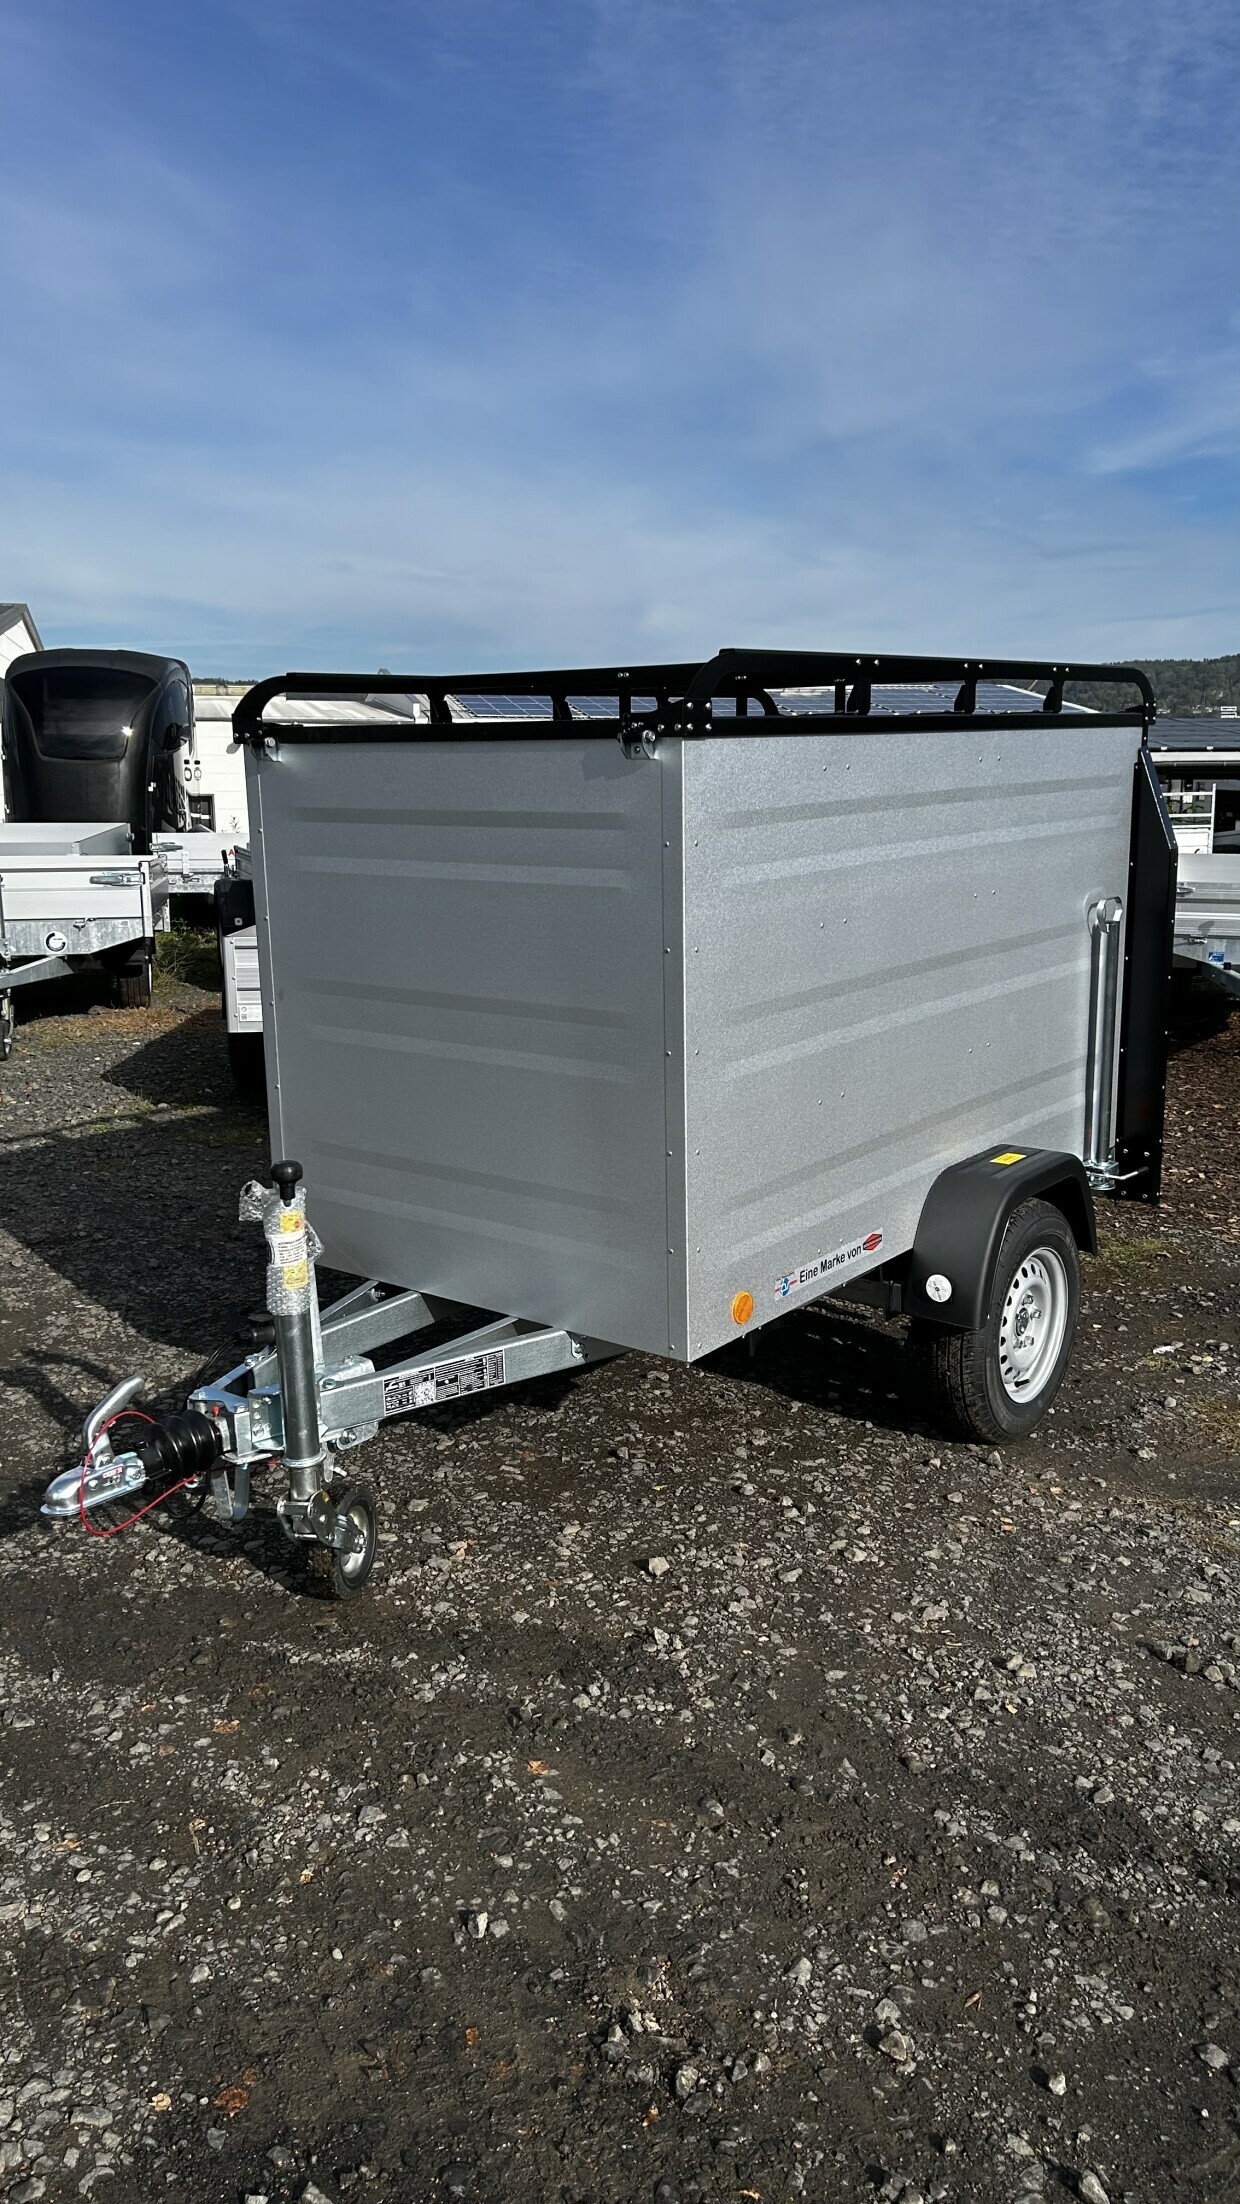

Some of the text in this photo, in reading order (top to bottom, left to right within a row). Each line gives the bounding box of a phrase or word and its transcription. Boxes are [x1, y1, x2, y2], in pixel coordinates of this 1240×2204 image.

[799, 1266, 818, 1283] Eine
[820, 1254, 845, 1273] Marke
[847, 1246, 862, 1260] von
